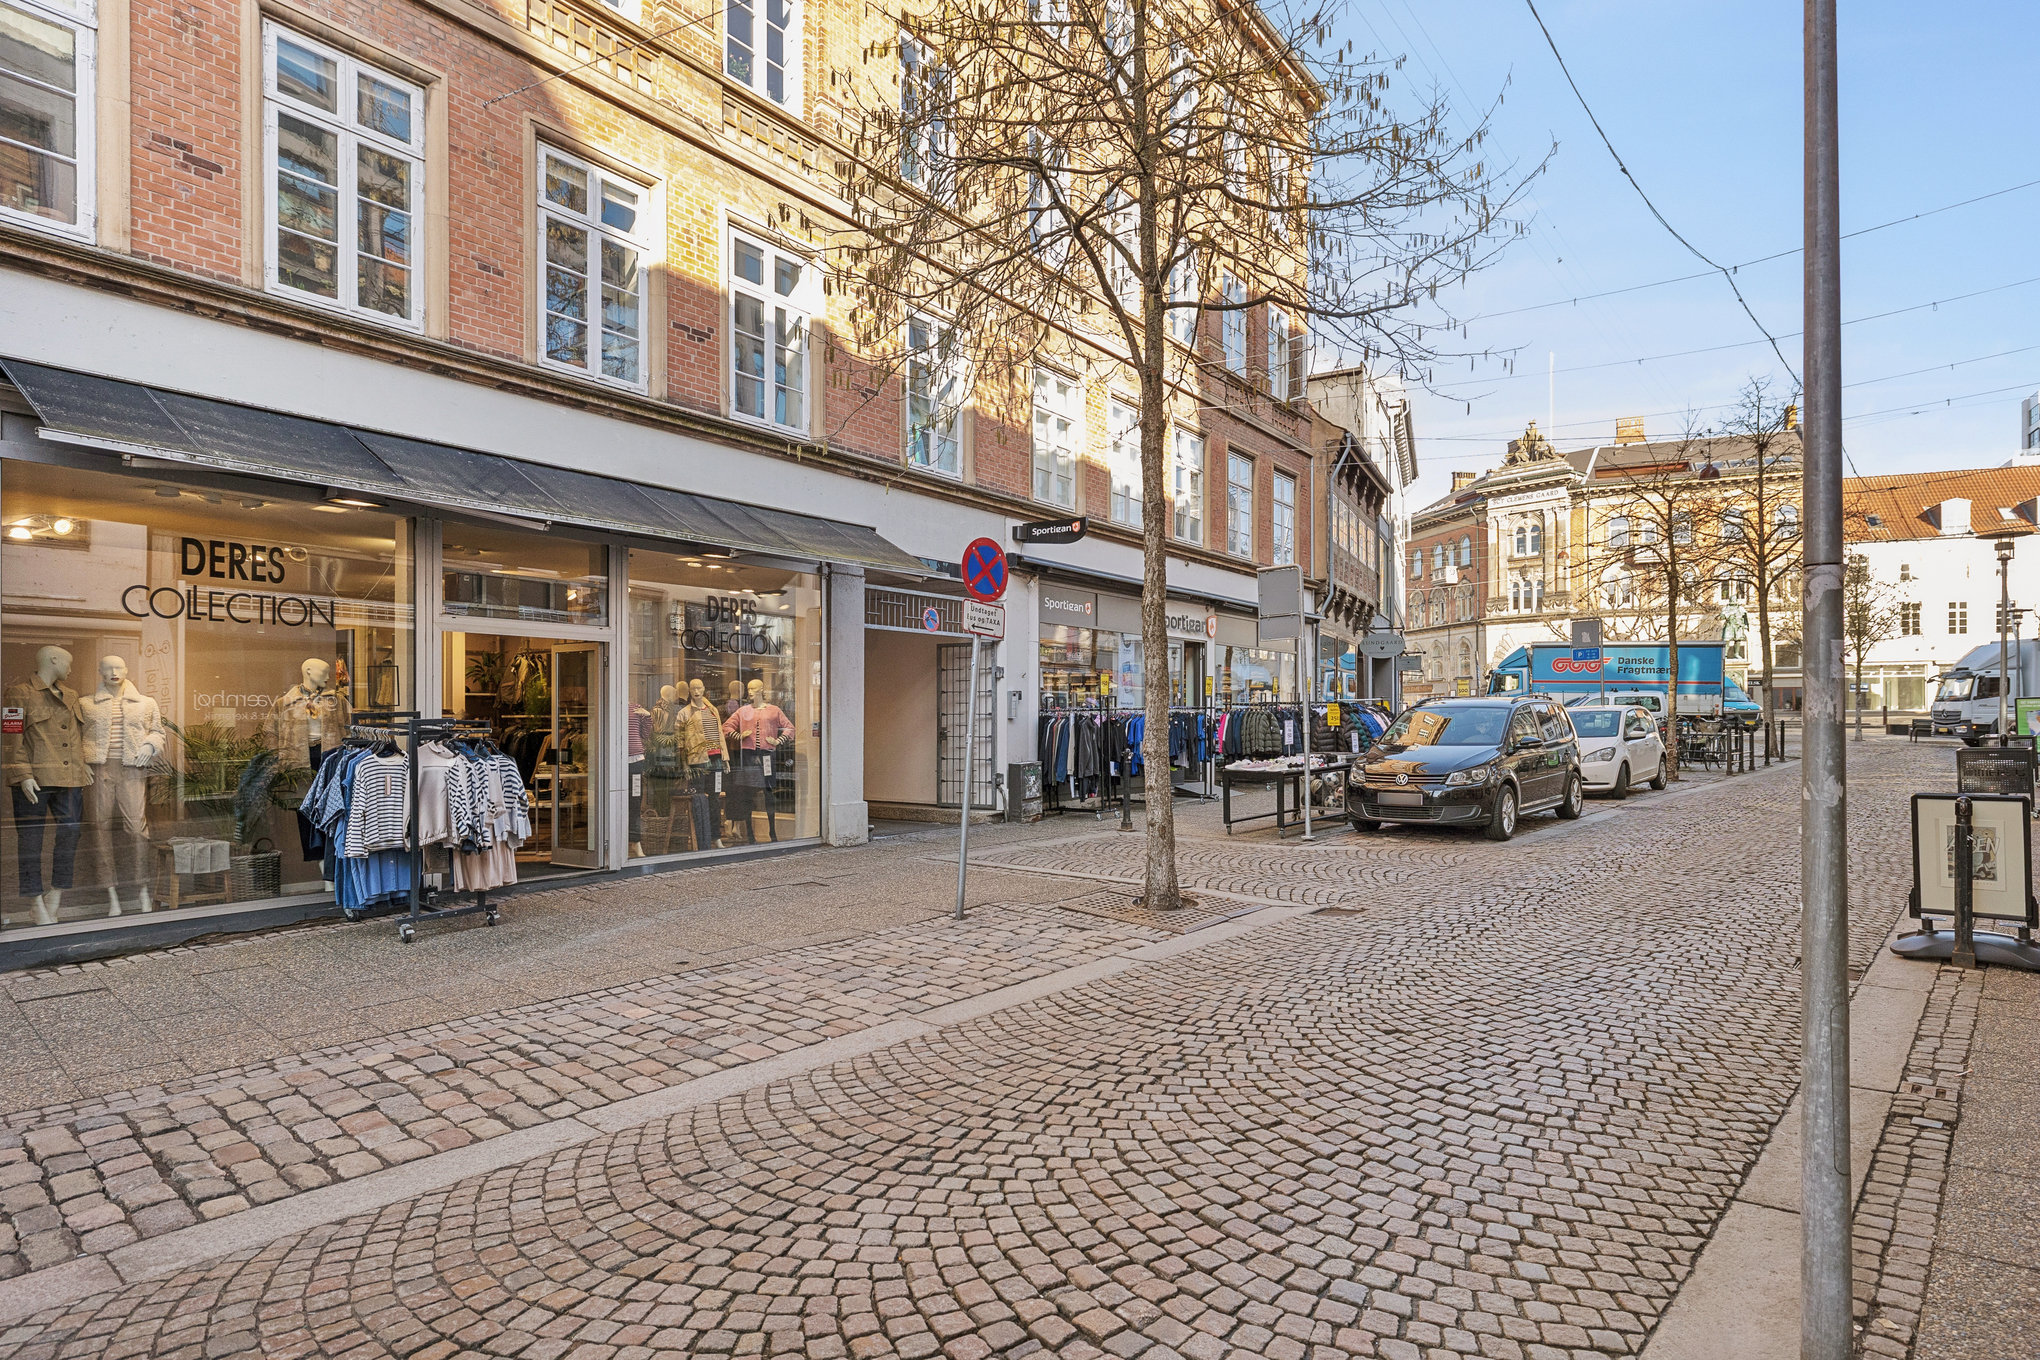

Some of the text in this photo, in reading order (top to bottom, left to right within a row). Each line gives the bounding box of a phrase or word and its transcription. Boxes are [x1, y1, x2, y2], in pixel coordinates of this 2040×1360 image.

[1536, 490, 1559, 498] GAARD
[1032, 525, 1072, 536] Sportigan
[181, 537, 285, 584] DERES
[121, 584, 335, 629] COLLECTION
[708, 595, 757, 625] DERES
[970, 604, 998, 617] Undtaget
[1044, 597, 1084, 612] Sportigan
[986, 617, 1001, 626] TAXA
[681, 627, 781, 656] COLLECTION
[1618, 657, 1655, 665] Danske
[1617, 666, 1671, 675] Fragtmæn
